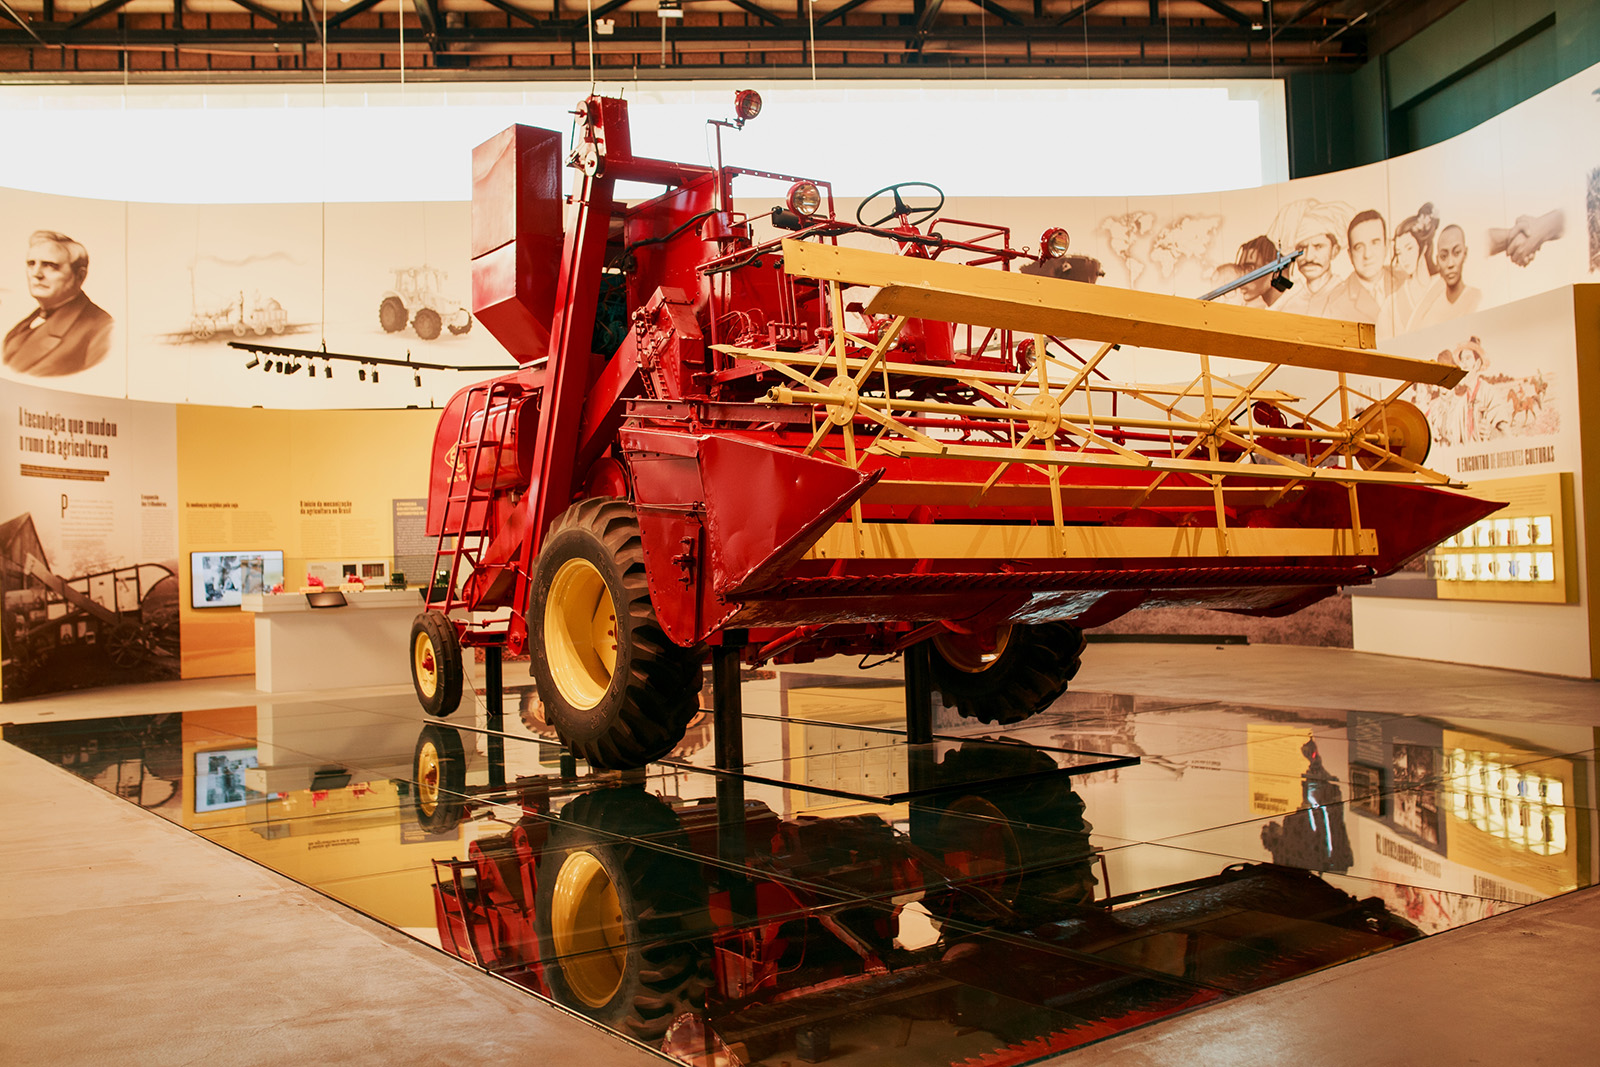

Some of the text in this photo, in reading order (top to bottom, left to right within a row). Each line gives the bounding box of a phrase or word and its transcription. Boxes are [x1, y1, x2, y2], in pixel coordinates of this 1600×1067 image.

[24, 408, 66, 436] tecnologia
[68, 418, 84, 441] que
[86, 417, 118, 438] mudou
[25, 436, 44, 454] rumo
[46, 434, 56, 455] da
[57, 438, 109, 461] agricultura
[1461, 453, 1490, 472] ENCONTRO
[1525, 445, 1555, 465] CULTURAS
[61, 494, 69, 519] P
